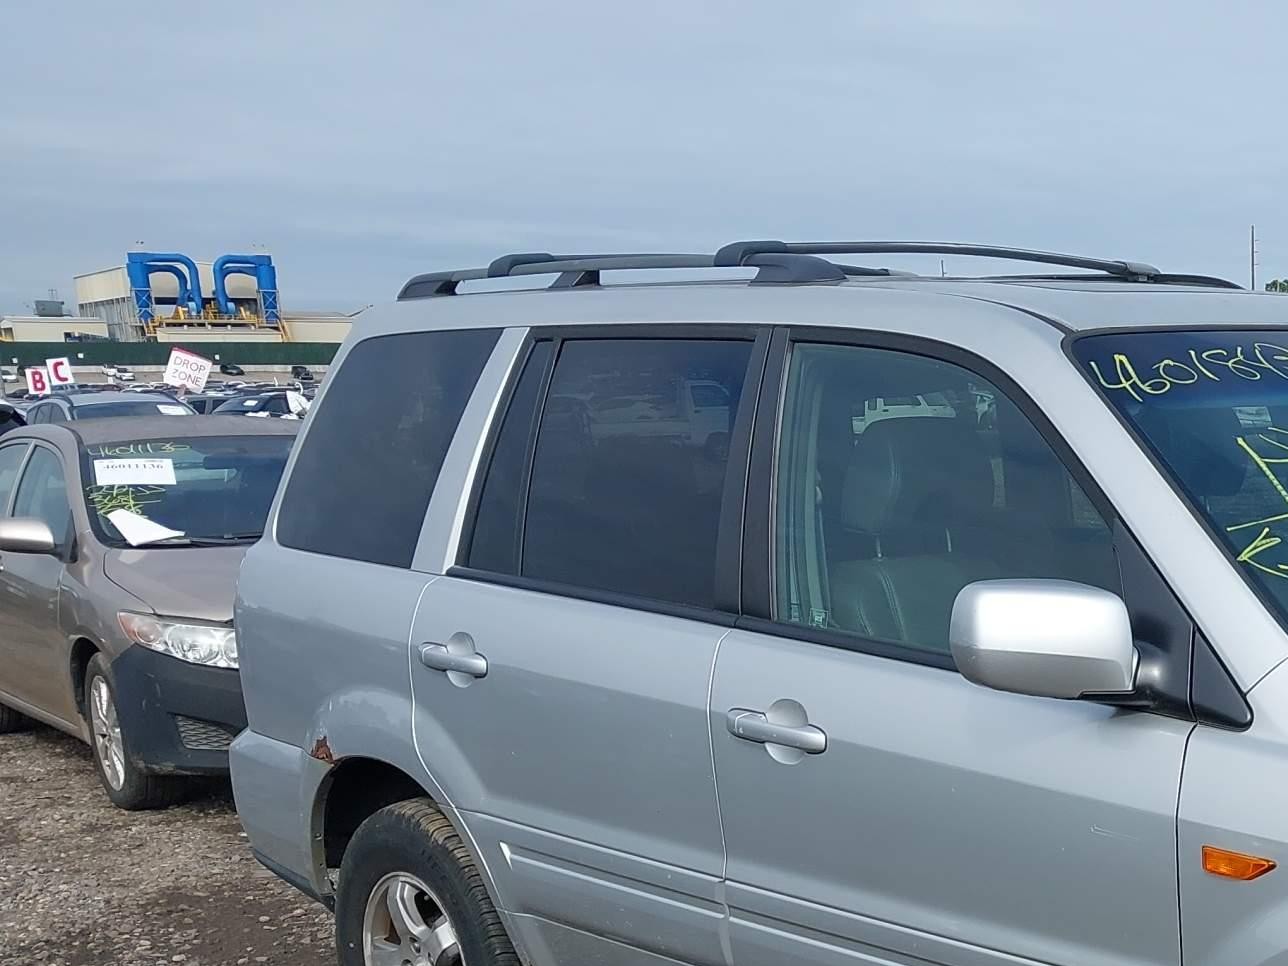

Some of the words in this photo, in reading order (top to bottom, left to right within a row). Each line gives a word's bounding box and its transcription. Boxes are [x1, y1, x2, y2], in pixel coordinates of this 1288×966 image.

[52, 361, 69, 383] C
[173, 355, 206, 373] DROP
[31, 371, 46, 392] B
[170, 368, 204, 387] ZONE
